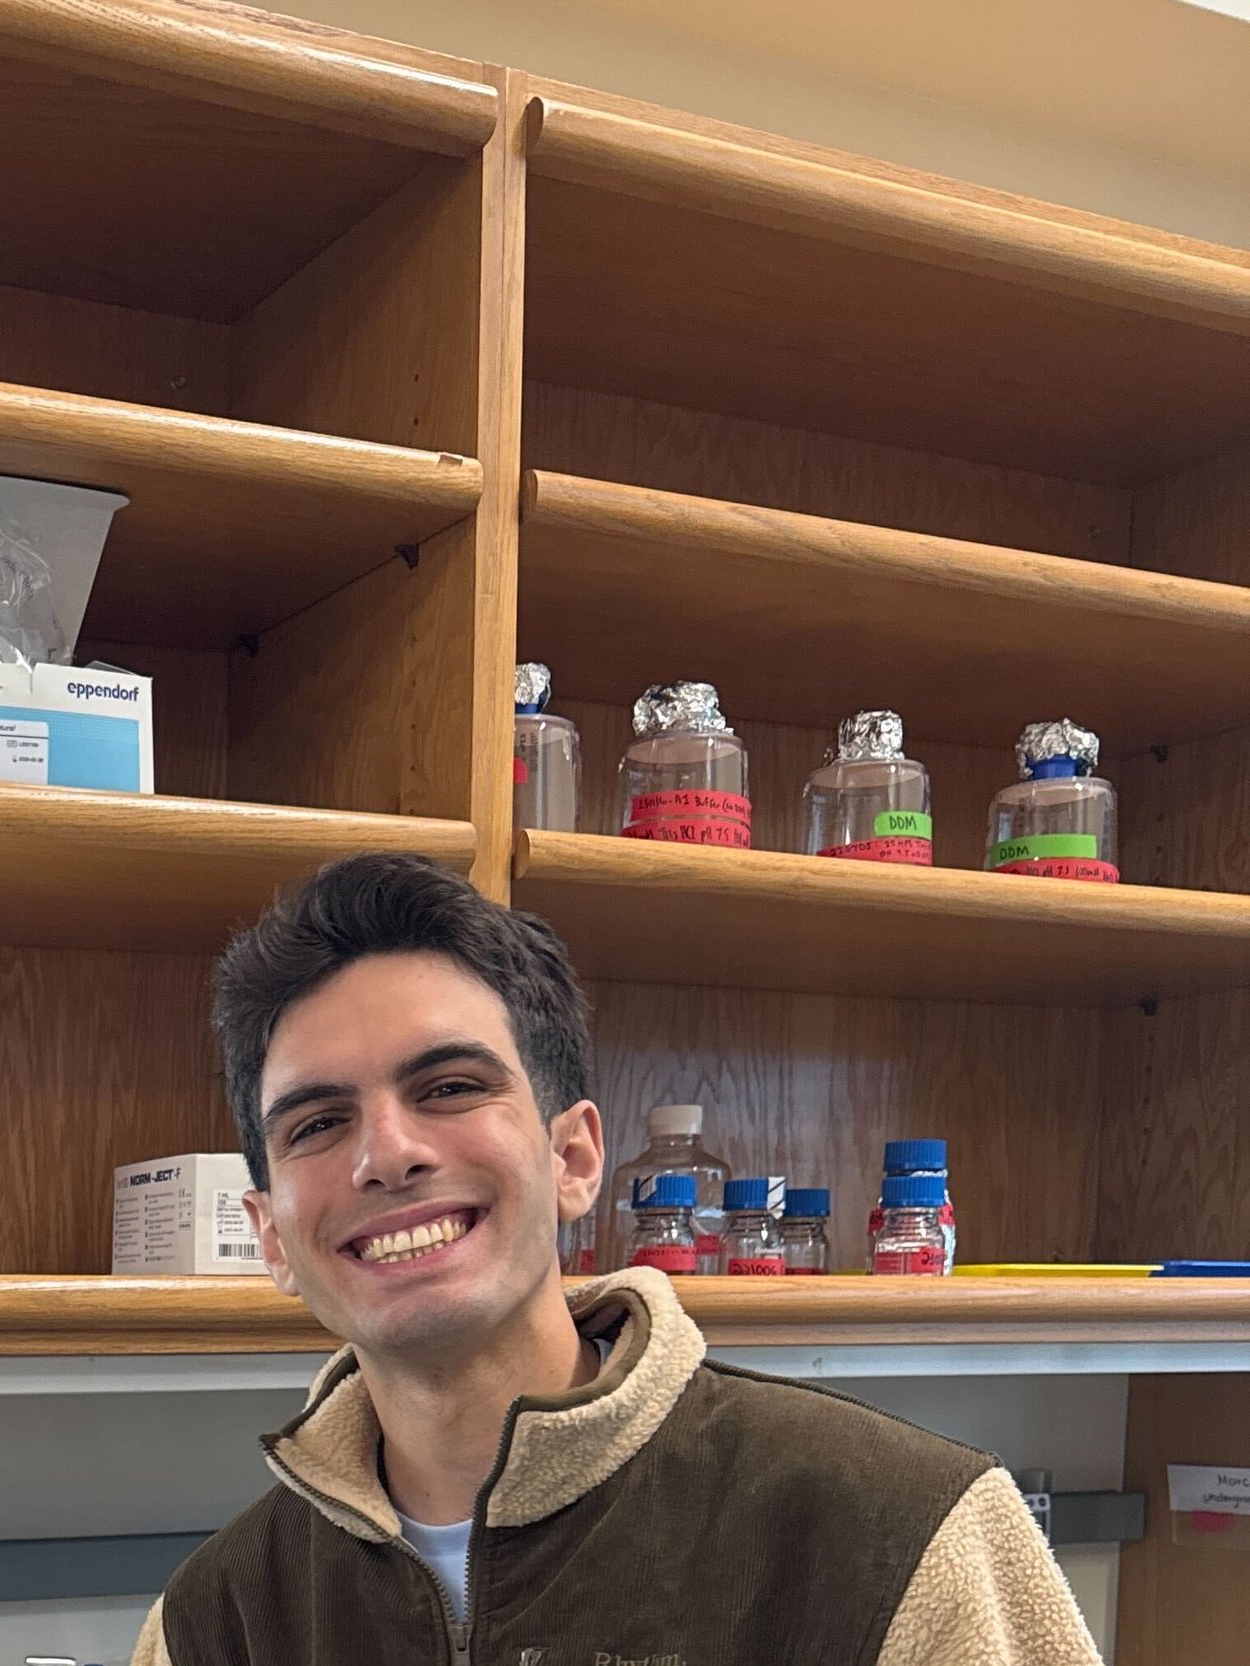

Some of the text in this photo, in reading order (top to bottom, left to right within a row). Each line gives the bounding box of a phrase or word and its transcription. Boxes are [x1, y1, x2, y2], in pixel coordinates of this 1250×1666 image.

[67, 681, 139, 702] eppendorf
[889, 815, 918, 831] DDM
[999, 846, 1029, 860] DDM
